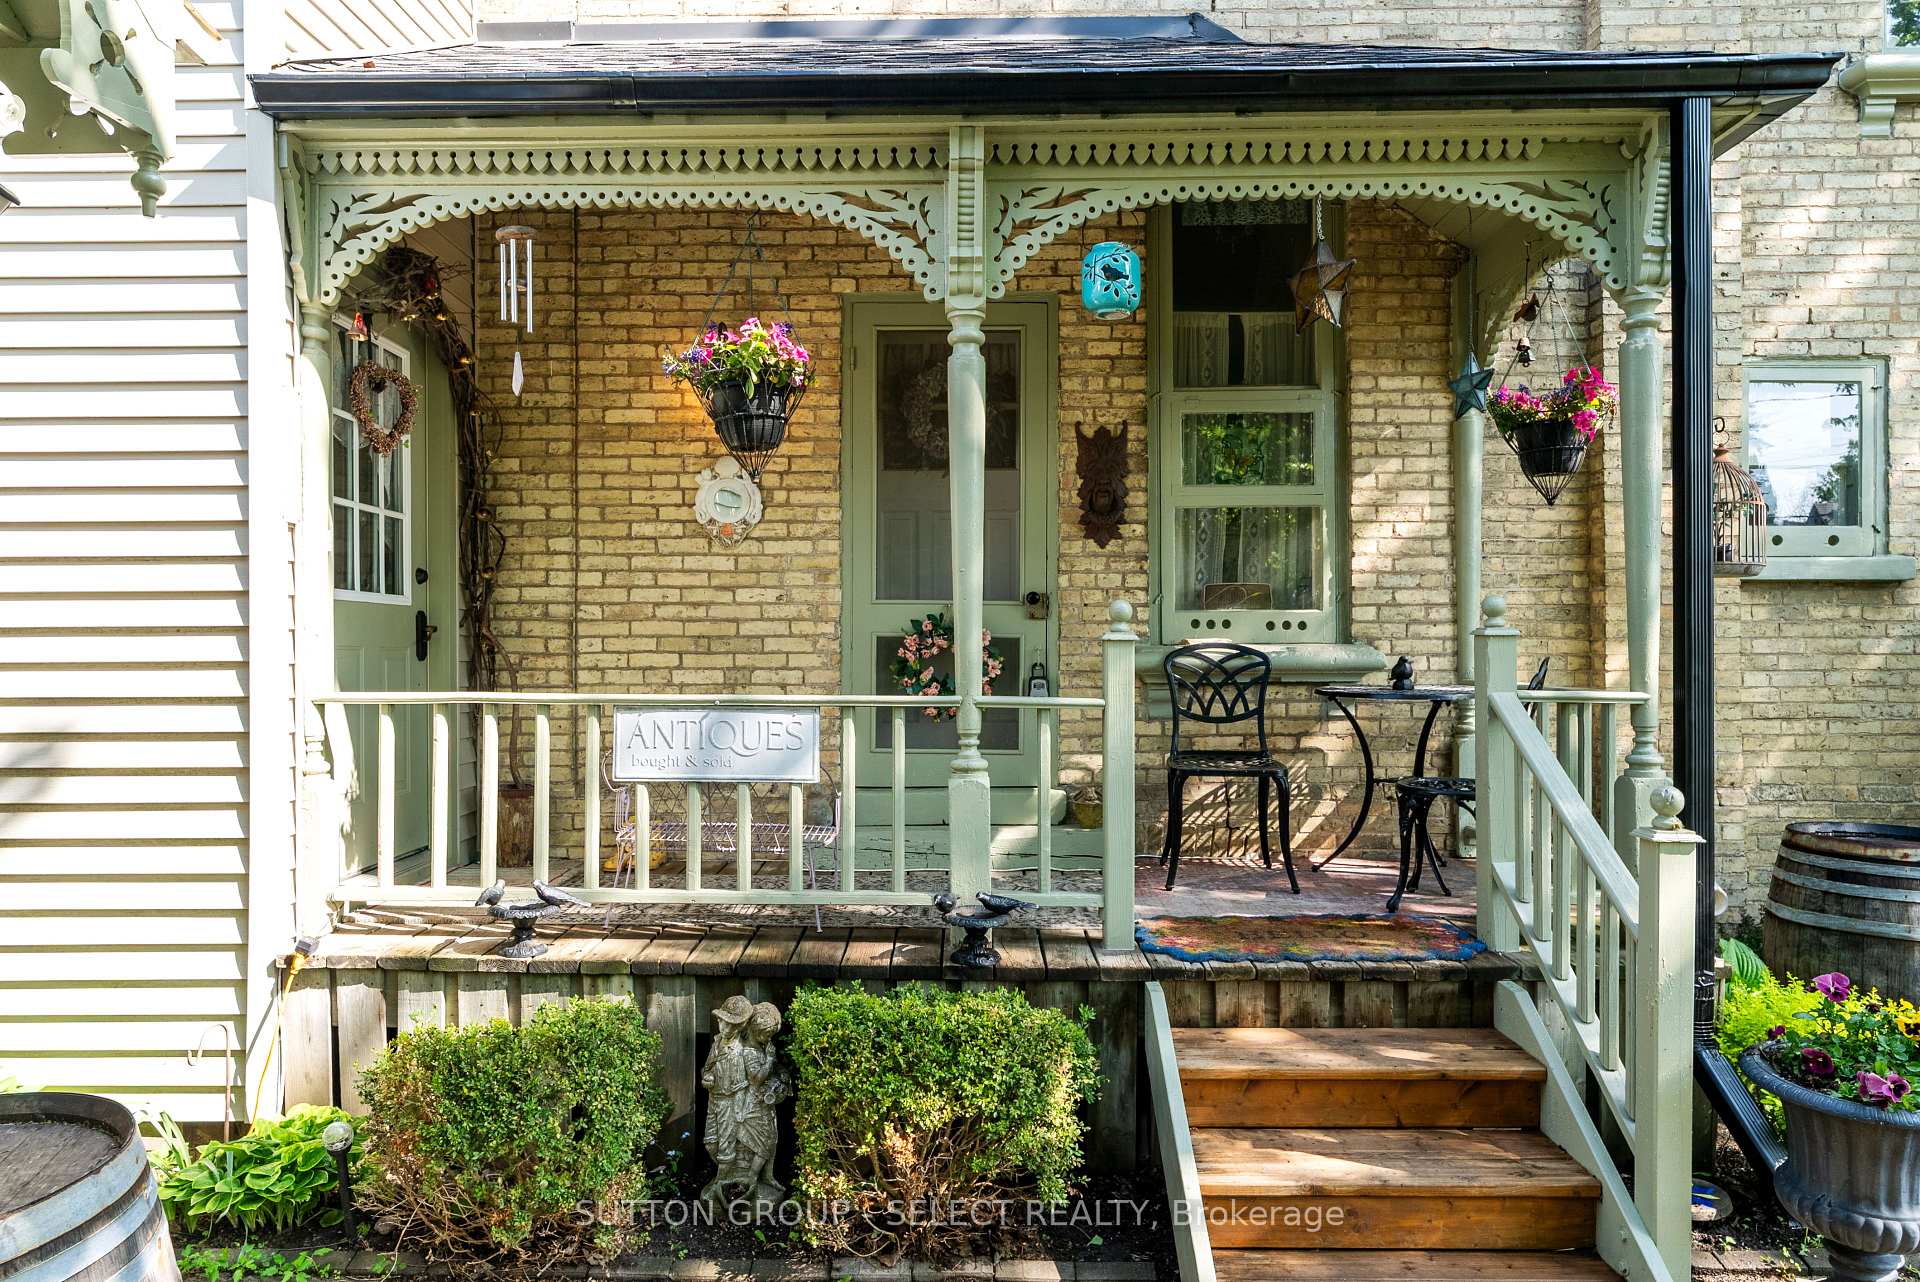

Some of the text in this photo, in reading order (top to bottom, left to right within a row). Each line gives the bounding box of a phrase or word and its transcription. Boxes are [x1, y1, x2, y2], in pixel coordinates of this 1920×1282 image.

[627, 713, 803, 757] ANTIQUES
[631, 754, 732, 769] bought & sold
